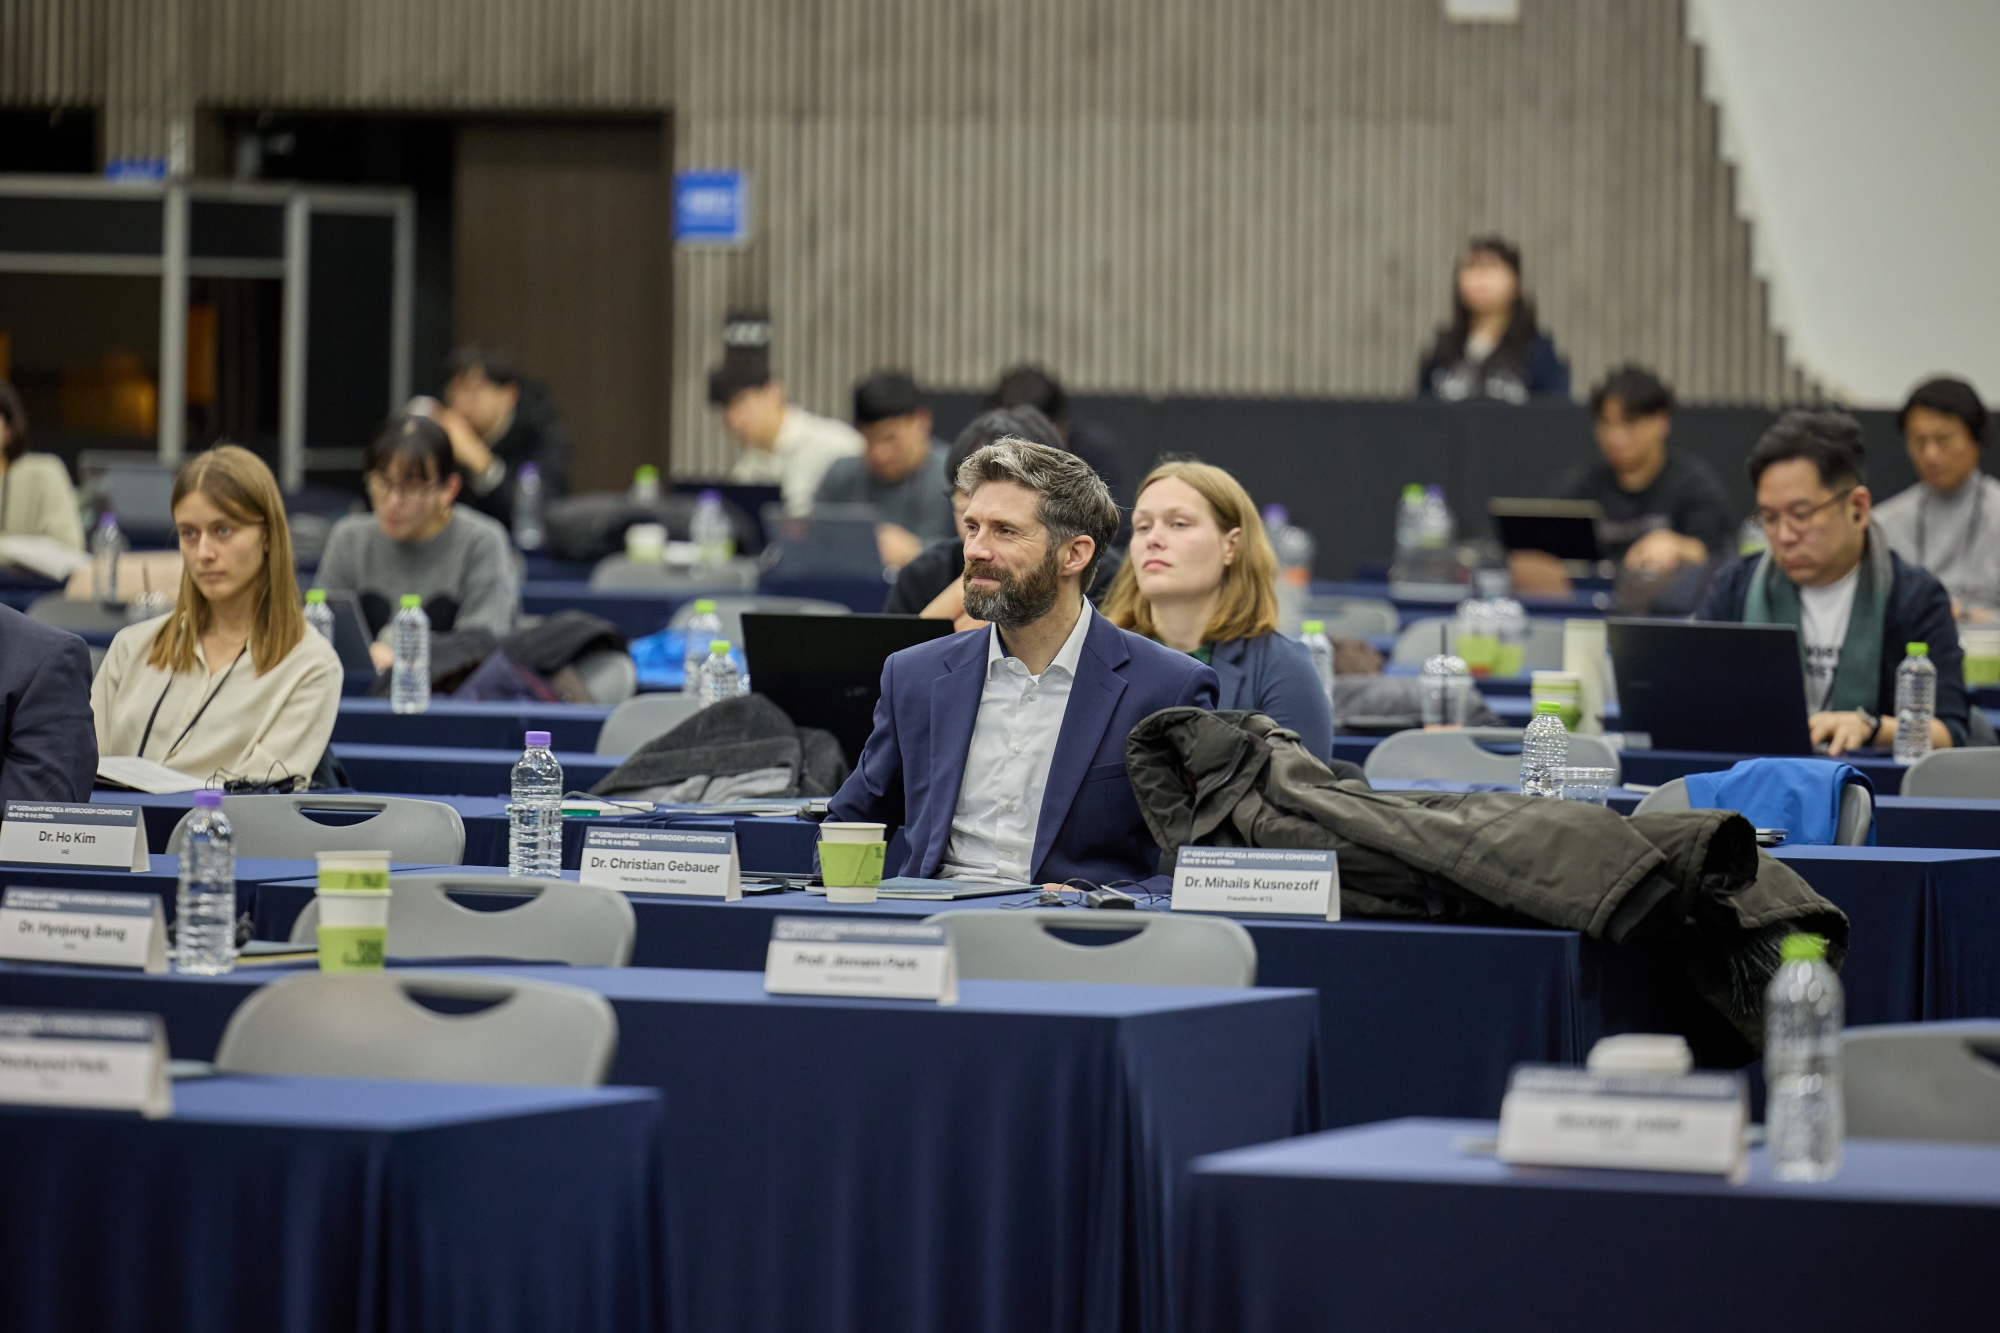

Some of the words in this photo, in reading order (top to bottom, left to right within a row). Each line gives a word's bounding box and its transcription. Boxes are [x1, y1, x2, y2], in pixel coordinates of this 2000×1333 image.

[17, 805, 63, 813] GERMANY-KOREA
[64, 807, 96, 815] HYDROGEN
[96, 808, 133, 816] CONFERENCE
[39, 830, 54, 842] Dr.
[56, 831, 72, 843] Ho
[73, 832, 96, 844] Kim
[651, 834, 686, 842] HYDROGEN
[686, 835, 727, 844] CONFERENCE
[1248, 852, 1284, 861] HYDROGEN
[1284, 853, 1327, 862] CONFERENCE
[591, 857, 607, 868] Dr.
[610, 858, 665, 871] Christian
[667, 859, 720, 873] Gebauer
[643, 876, 667, 884] Precious
[1184, 875, 1202, 888] Dr.
[1204, 876, 1250, 889] Mihails
[1253, 878, 1320, 891] Kusnezoff
[18, 919, 35, 933] Dr.
